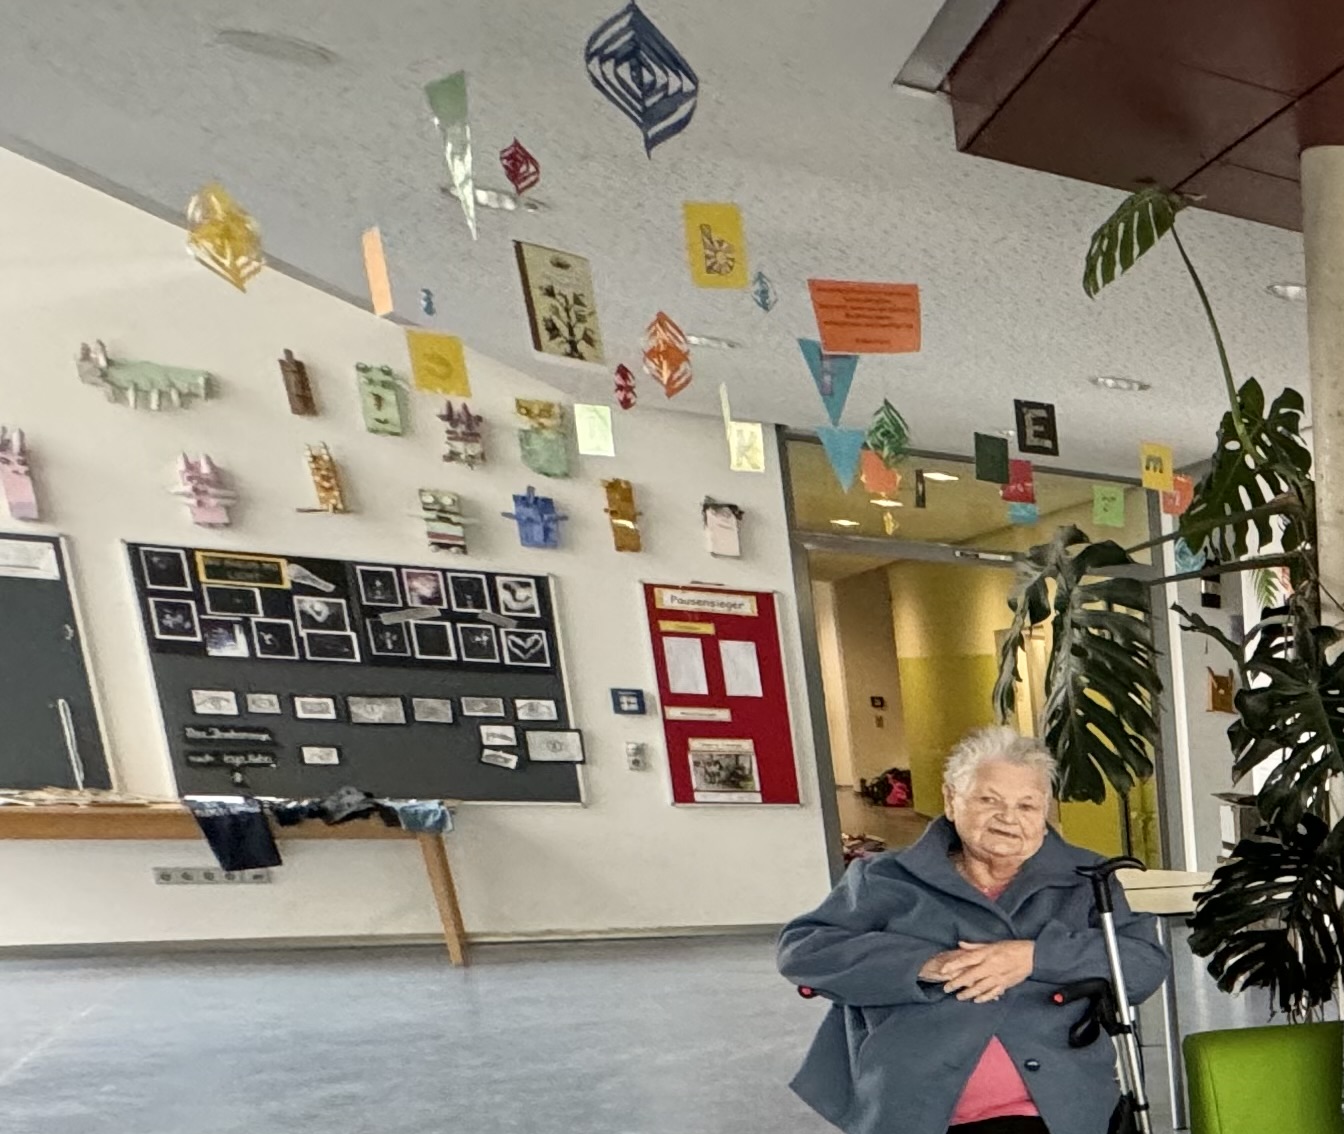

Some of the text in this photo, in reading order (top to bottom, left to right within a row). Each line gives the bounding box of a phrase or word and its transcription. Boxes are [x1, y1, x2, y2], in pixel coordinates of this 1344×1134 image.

[1022, 407, 1053, 449] E
[735, 429, 761, 470] K
[670, 594, 745, 611] Pausensieger
